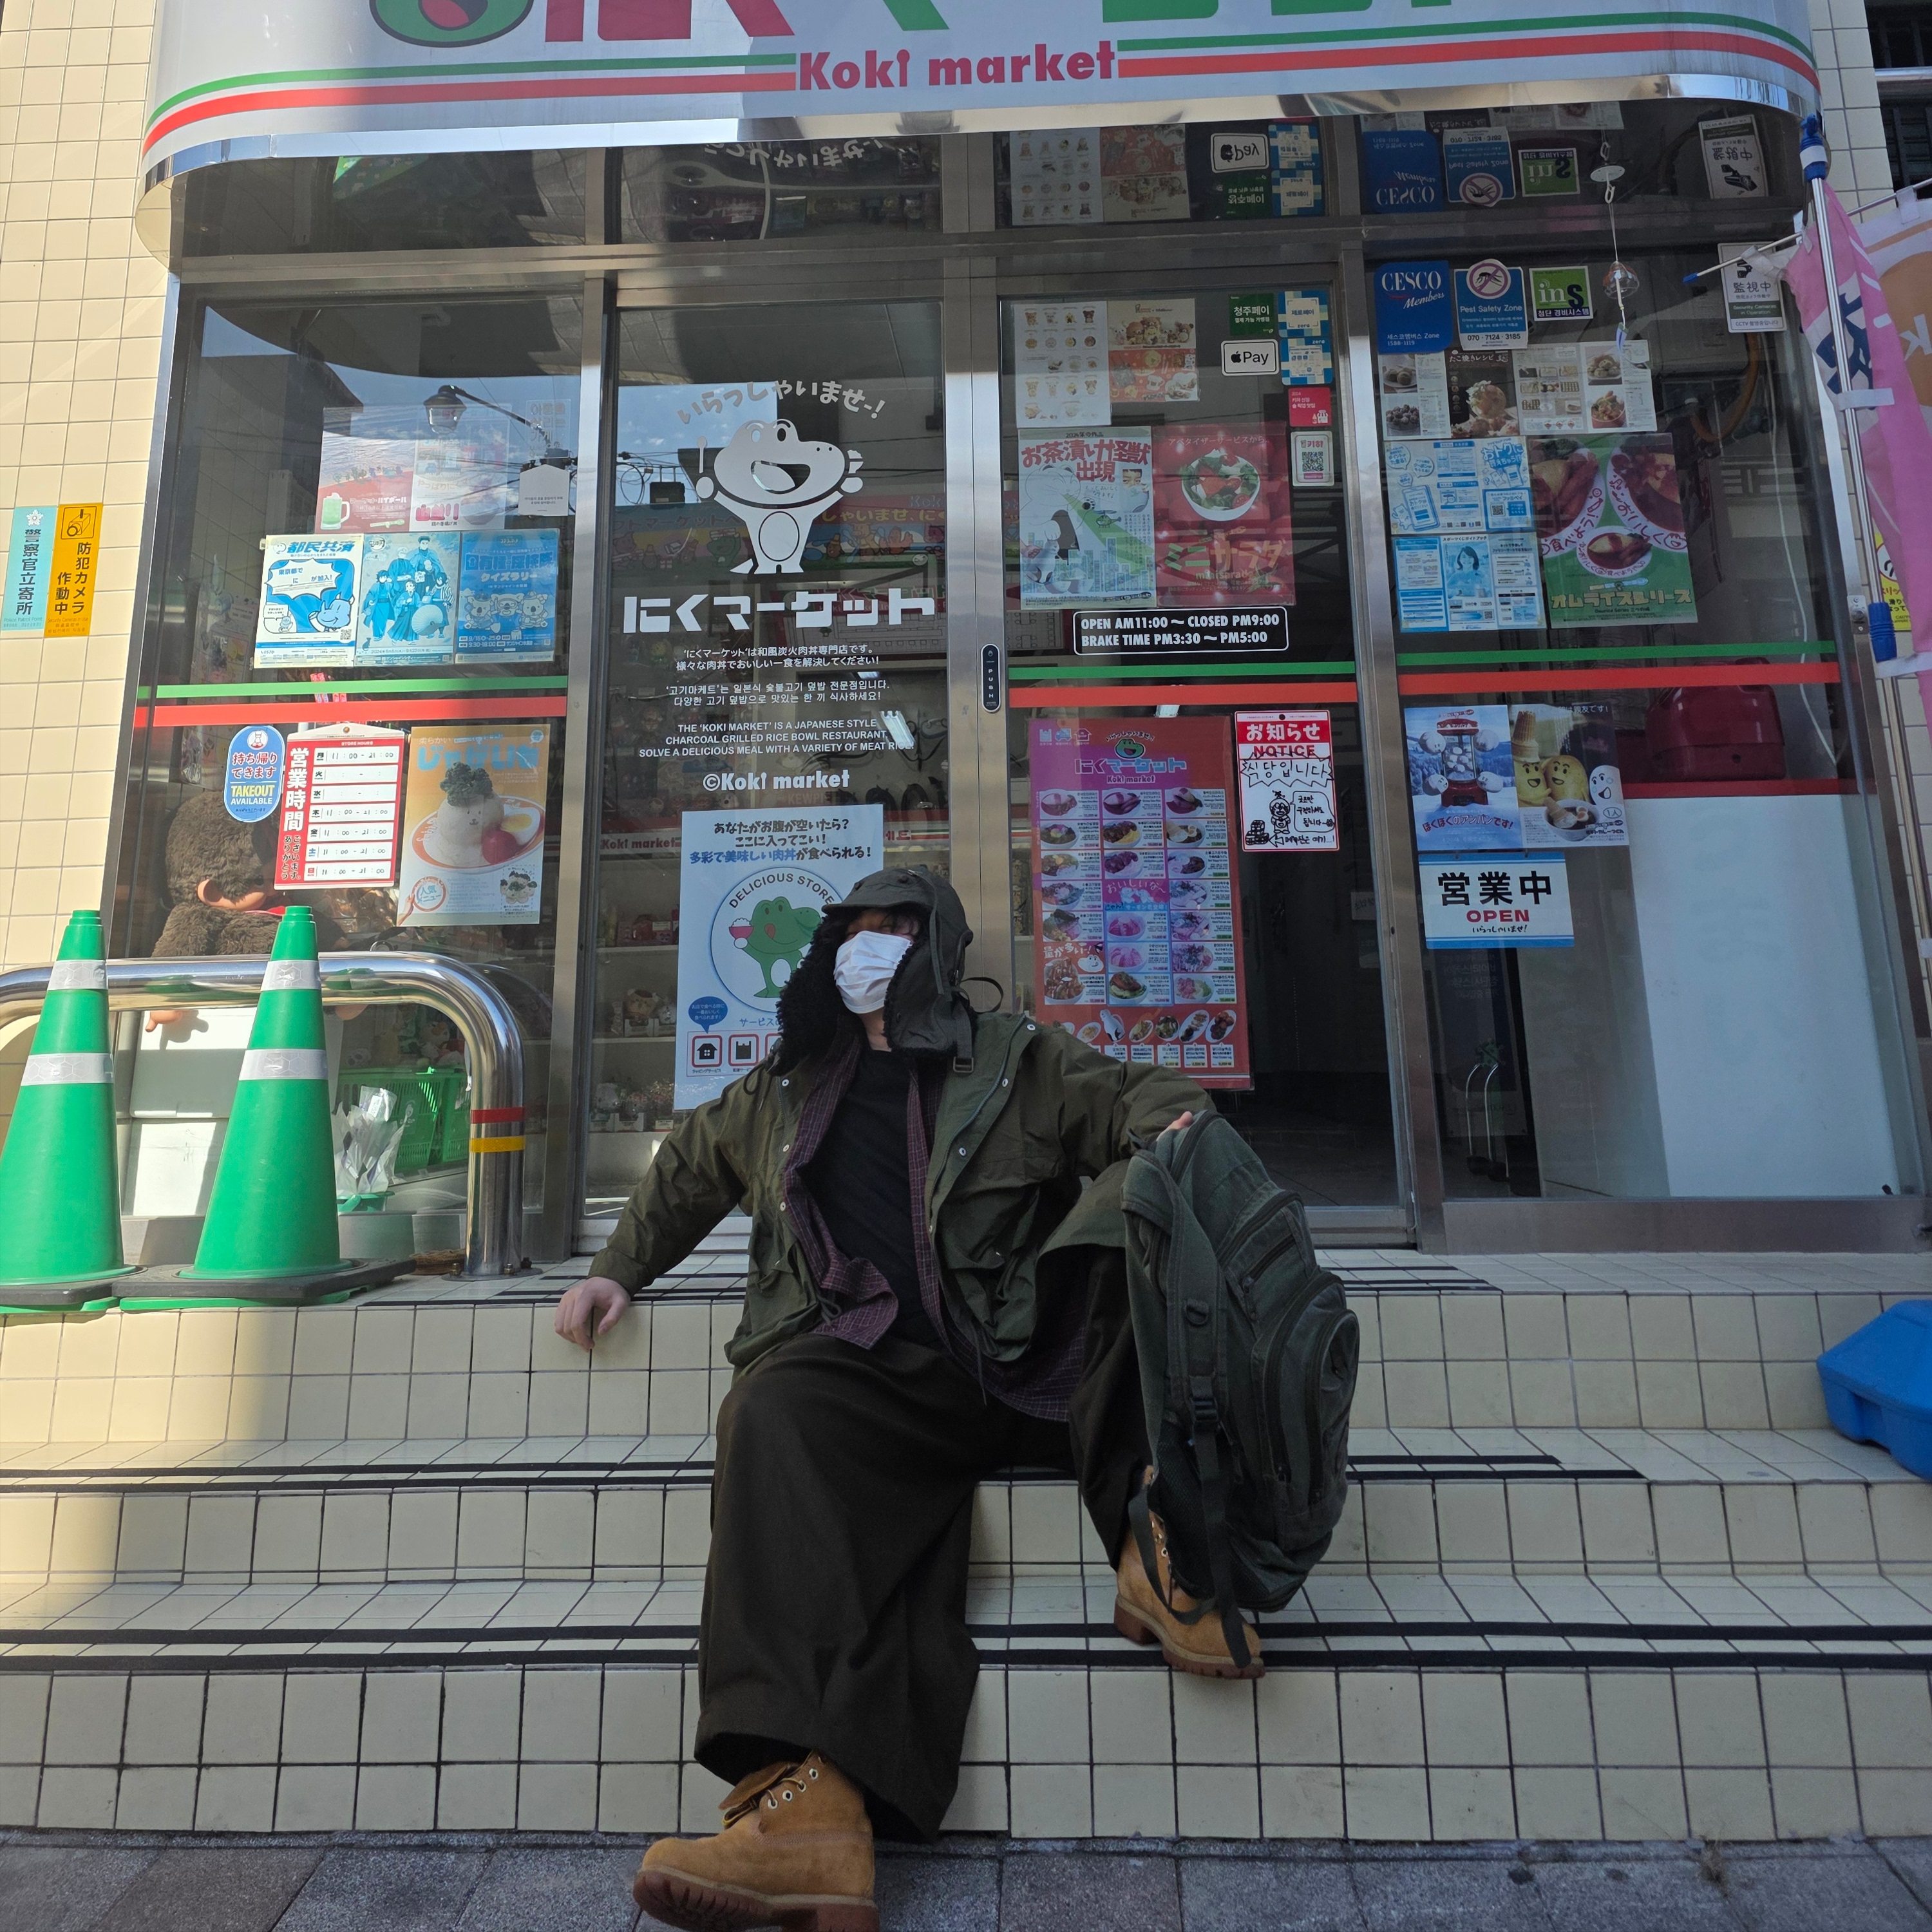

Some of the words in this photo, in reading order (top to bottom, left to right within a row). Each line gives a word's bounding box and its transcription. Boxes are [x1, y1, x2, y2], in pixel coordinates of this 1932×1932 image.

[799, 49, 909, 90] Koki
[929, 40, 1115, 86] market
[1381, 271, 1441, 291] CESCO
[1734, 281, 1771, 293] 監視中
[1403, 291, 1445, 309] Members
[1234, 305, 1269, 316] 청주페이
[1243, 351, 1269, 365] Pay
[1449, 353, 1494, 363] たこ焼きレシピ
[1021, 439, 1151, 468] お茶漬け怪獣
[1481, 442, 1524, 461] おトクに
[1076, 460, 1115, 482] 出現
[287, 541, 355, 553] 都民共済
[16, 529, 41, 615] 警察官立寄所
[72, 542, 91, 614] 防犯カメラ
[481, 572, 537, 582] クイズラリー
[55, 572, 71, 615] 作動中
[623, 588, 935, 633] にくマーケット
[1081, 618, 1111, 630] OPEN
[1115, 617, 1168, 629] AM11:00
[1188, 616, 1228, 627] CLOSED
[1232, 614, 1279, 626] PM9:00
[1082, 635, 1119, 647] BRAKE
[1122, 634, 1150, 645] TIME
[1155, 633, 1200, 645] PM3:30
[1220, 632, 1267, 644] PM5:00
[676, 656, 879, 671] 様々な肉丼でおいしい一食を解決してください!
[734, 683, 761, 694] 일본식
[766, 681, 803, 693] 숯불고기
[808, 681, 825, 692] 덮밥
[830, 679, 890, 691] 전문점입니다.
[674, 696, 702, 706] 다양한
[706, 695, 725, 706] 고기
[730, 694, 766, 705] 덮밥으로
[772, 693, 799, 704] 맛있는
[803, 692, 813, 703] 한
[817, 692, 826, 703] 끼
[830, 691, 881, 702] 식사하세요!
[677, 724, 697, 733] THE
[774, 721, 782, 730] IS
[785, 721, 793, 730] A
[795, 720, 844, 730] JAPANESE
[847, 719, 876, 728] STYLE
[1246, 723, 1320, 741] お知らせ
[665, 735, 719, 745] CHARCOAL
[722, 734, 764, 743] GRILLED
[766, 732, 789, 742] RICE
[791, 732, 820, 741] BOWL
[822, 730, 888, 740] RESTAURANT.
[639, 748, 670, 758] SOLVE
[672, 748, 679, 756] A
[682, 746, 734, 756] DELICIOUS
[737, 745, 763, 755] MEAL
[766, 744, 790, 753] WITH
[792, 744, 799, 752] A
[801, 743, 842, 752] VARIETY
[845, 743, 860, 751] OF
[862, 742, 886, 750] MEAT
[1253, 745, 1314, 757] NOTICE
[232, 753, 277, 765] 持ち帰り
[1074, 757, 1187, 774] にくマーケット
[232, 766, 276, 779] できます
[1247, 759, 1328, 779] 식당입니다
[773, 770, 849, 790] market
[231, 785, 275, 797] TAKEOUT
[283, 748, 309, 831] 営業時間
[714, 819, 849, 834] あなたがお腹が空いたら?
[1422, 813, 1513, 833] ほくほくのアンパンです!
[601, 838, 629, 849] Koki
[631, 837, 676, 848] market
[735, 835, 826, 848] ここに入ってこい!
[281, 835, 292, 880] ありがとう
[689, 847, 871, 864] 多彩で美味しい肉丼が食べられる!
[420, 885, 437, 896] 人気
[729, 873, 794, 909] DELICIOUS
[797, 876, 835, 905] STORE
[1437, 870, 1551, 906] 営業中
[419, 893, 441, 904] メニュー
[1466, 909, 1530, 923] OPEN
